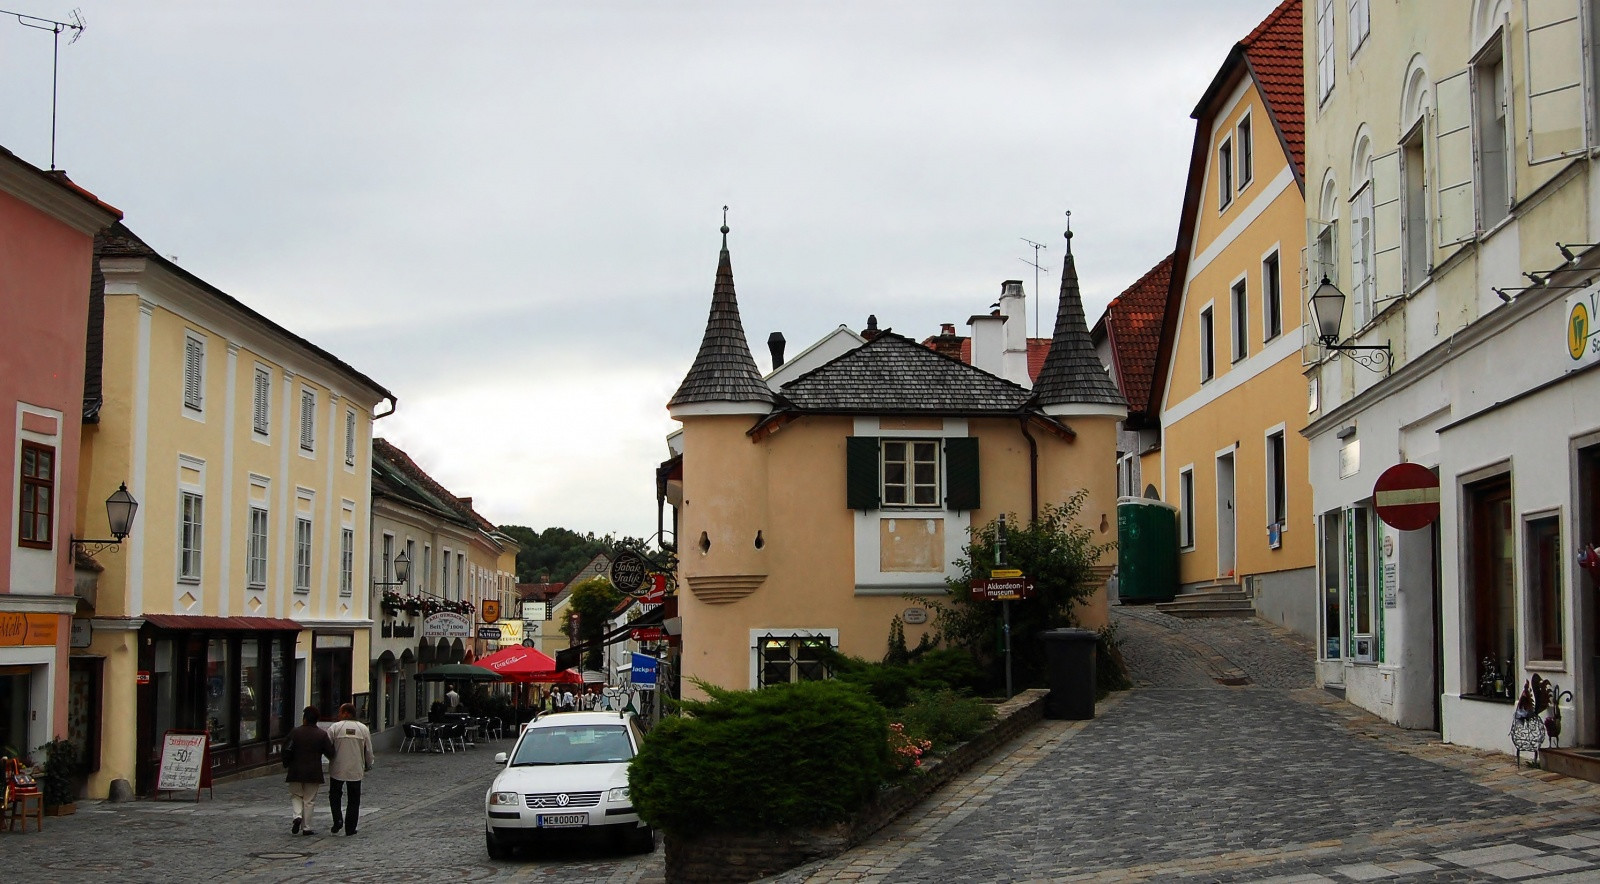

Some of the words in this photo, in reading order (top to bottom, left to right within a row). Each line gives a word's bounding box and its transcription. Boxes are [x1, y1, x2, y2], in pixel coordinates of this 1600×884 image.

[615, 561, 641, 572] Tabak
[614, 572, 641, 585] Trafik
[987, 582, 1023, 590] Akkordeon-
[632, 665, 656, 675] Jackpot
